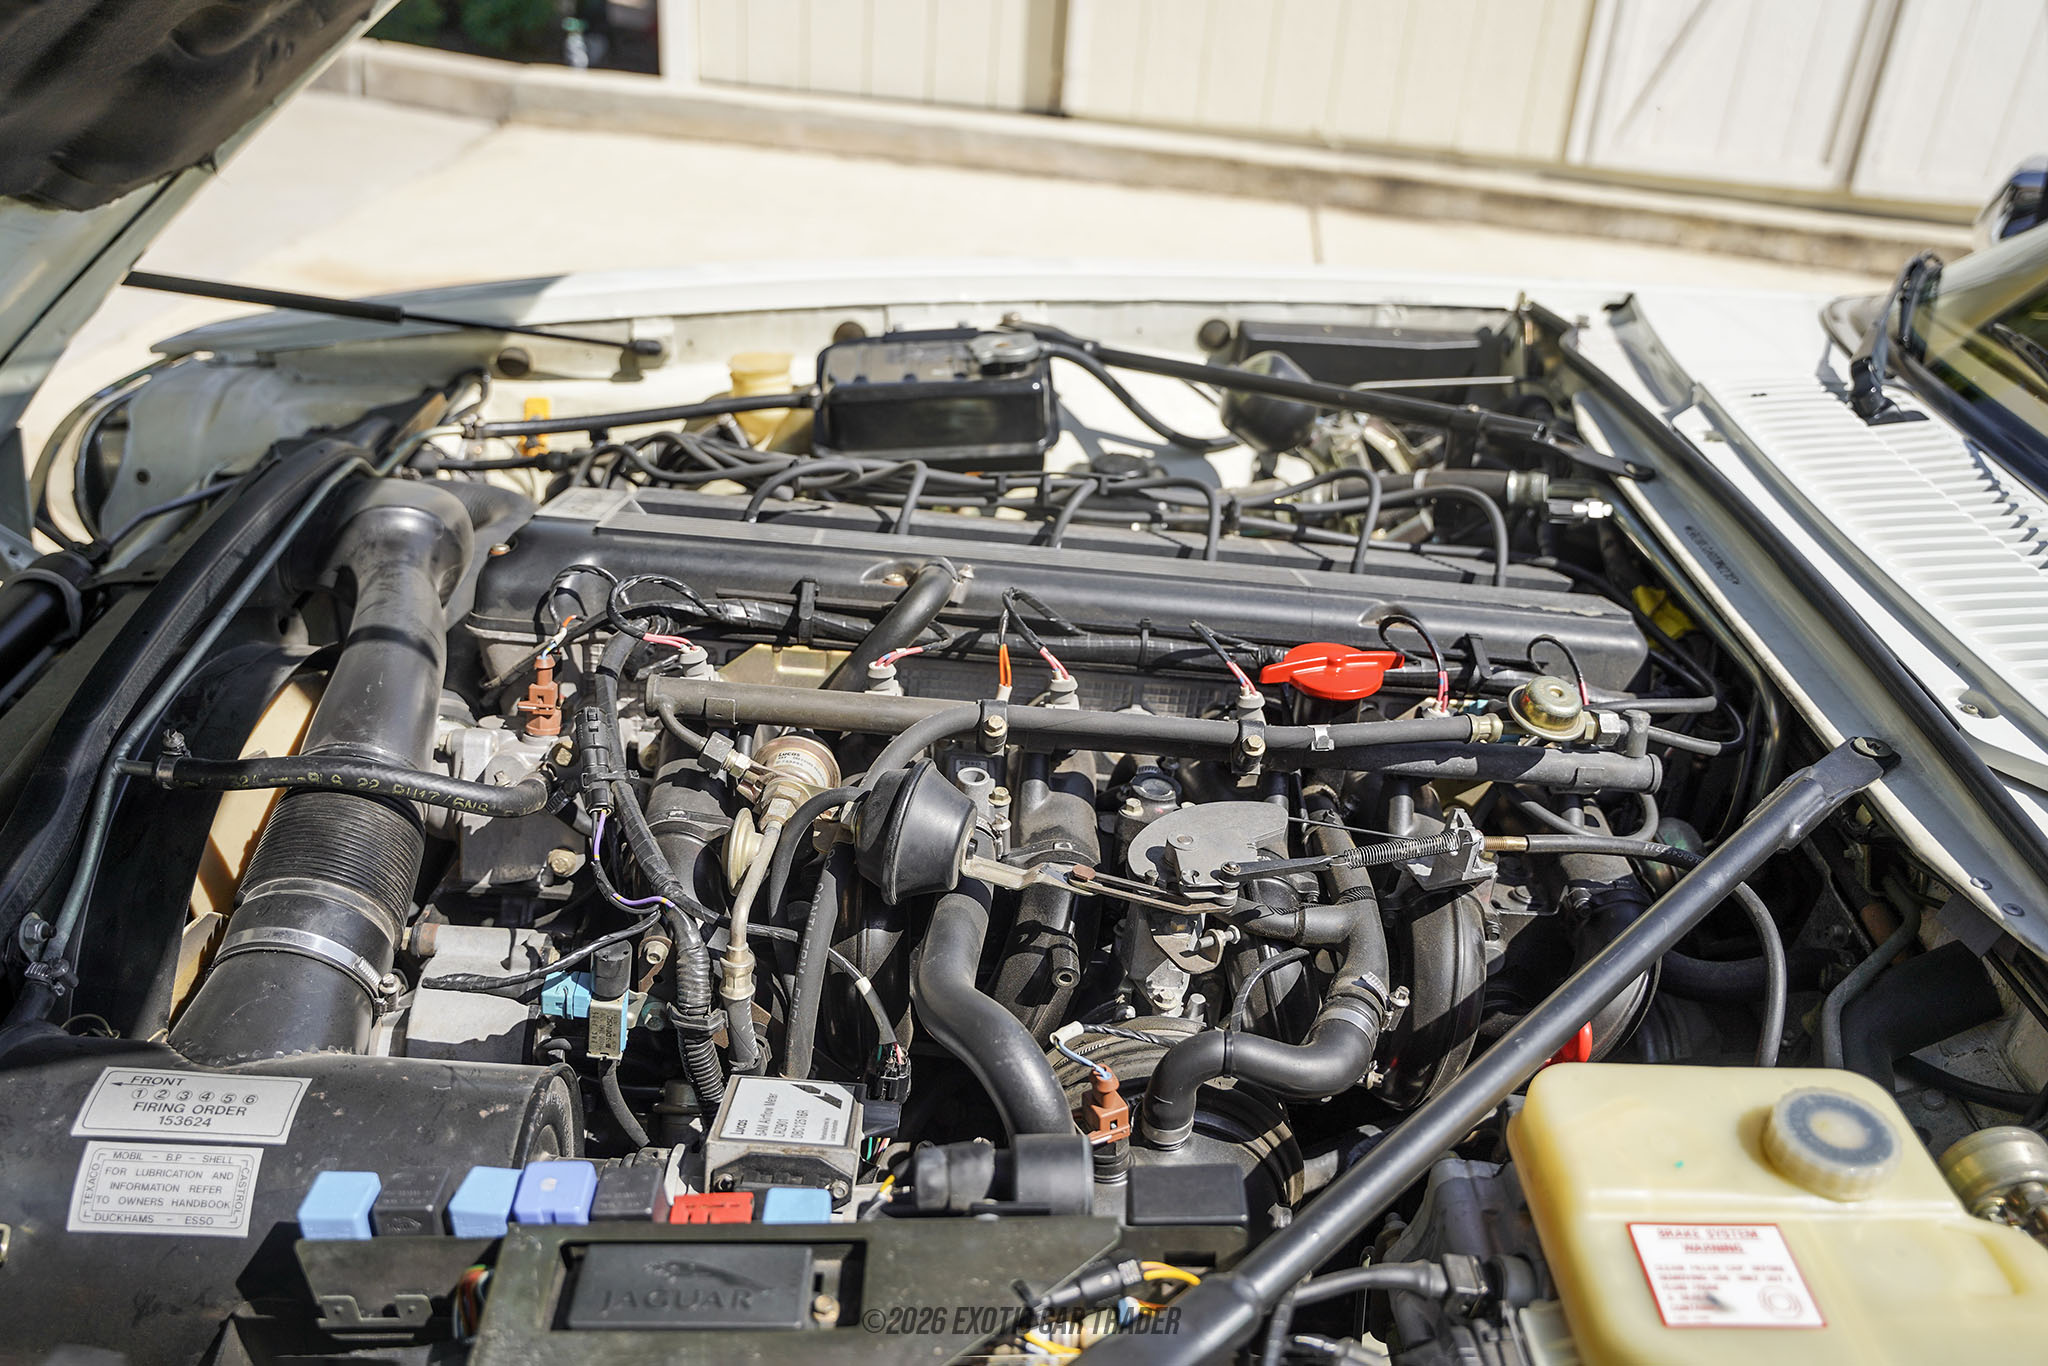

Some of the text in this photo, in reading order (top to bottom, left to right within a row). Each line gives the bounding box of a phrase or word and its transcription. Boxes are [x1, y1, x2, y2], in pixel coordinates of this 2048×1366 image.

[130, 1075, 186, 1086] FRONT
[133, 1088, 258, 1105] 1 2 3 4 5 6
[764, 1092, 778, 1106] Meter
[132, 1102, 248, 1116] FIRING ORDER
[159, 1116, 212, 1128] 153624
[729, 1120, 748, 1135] Lucas
[112, 1152, 144, 1160] MOBIL
[202, 1154, 232, 1164] SHELL
[104, 1166, 234, 1180] FOR LUBRICATION AND
[82, 1162, 100, 1206] TEXACO
[110, 1182, 223, 1194] INFORMATION REFER
[234, 1168, 250, 1214] CASTROL
[96, 1195, 231, 1209] TO OWNERS HANDBOOK
[94, 1212, 214, 1226] DUCKHAMS ESSO
[600, 1288, 754, 1312] JAGUAR
